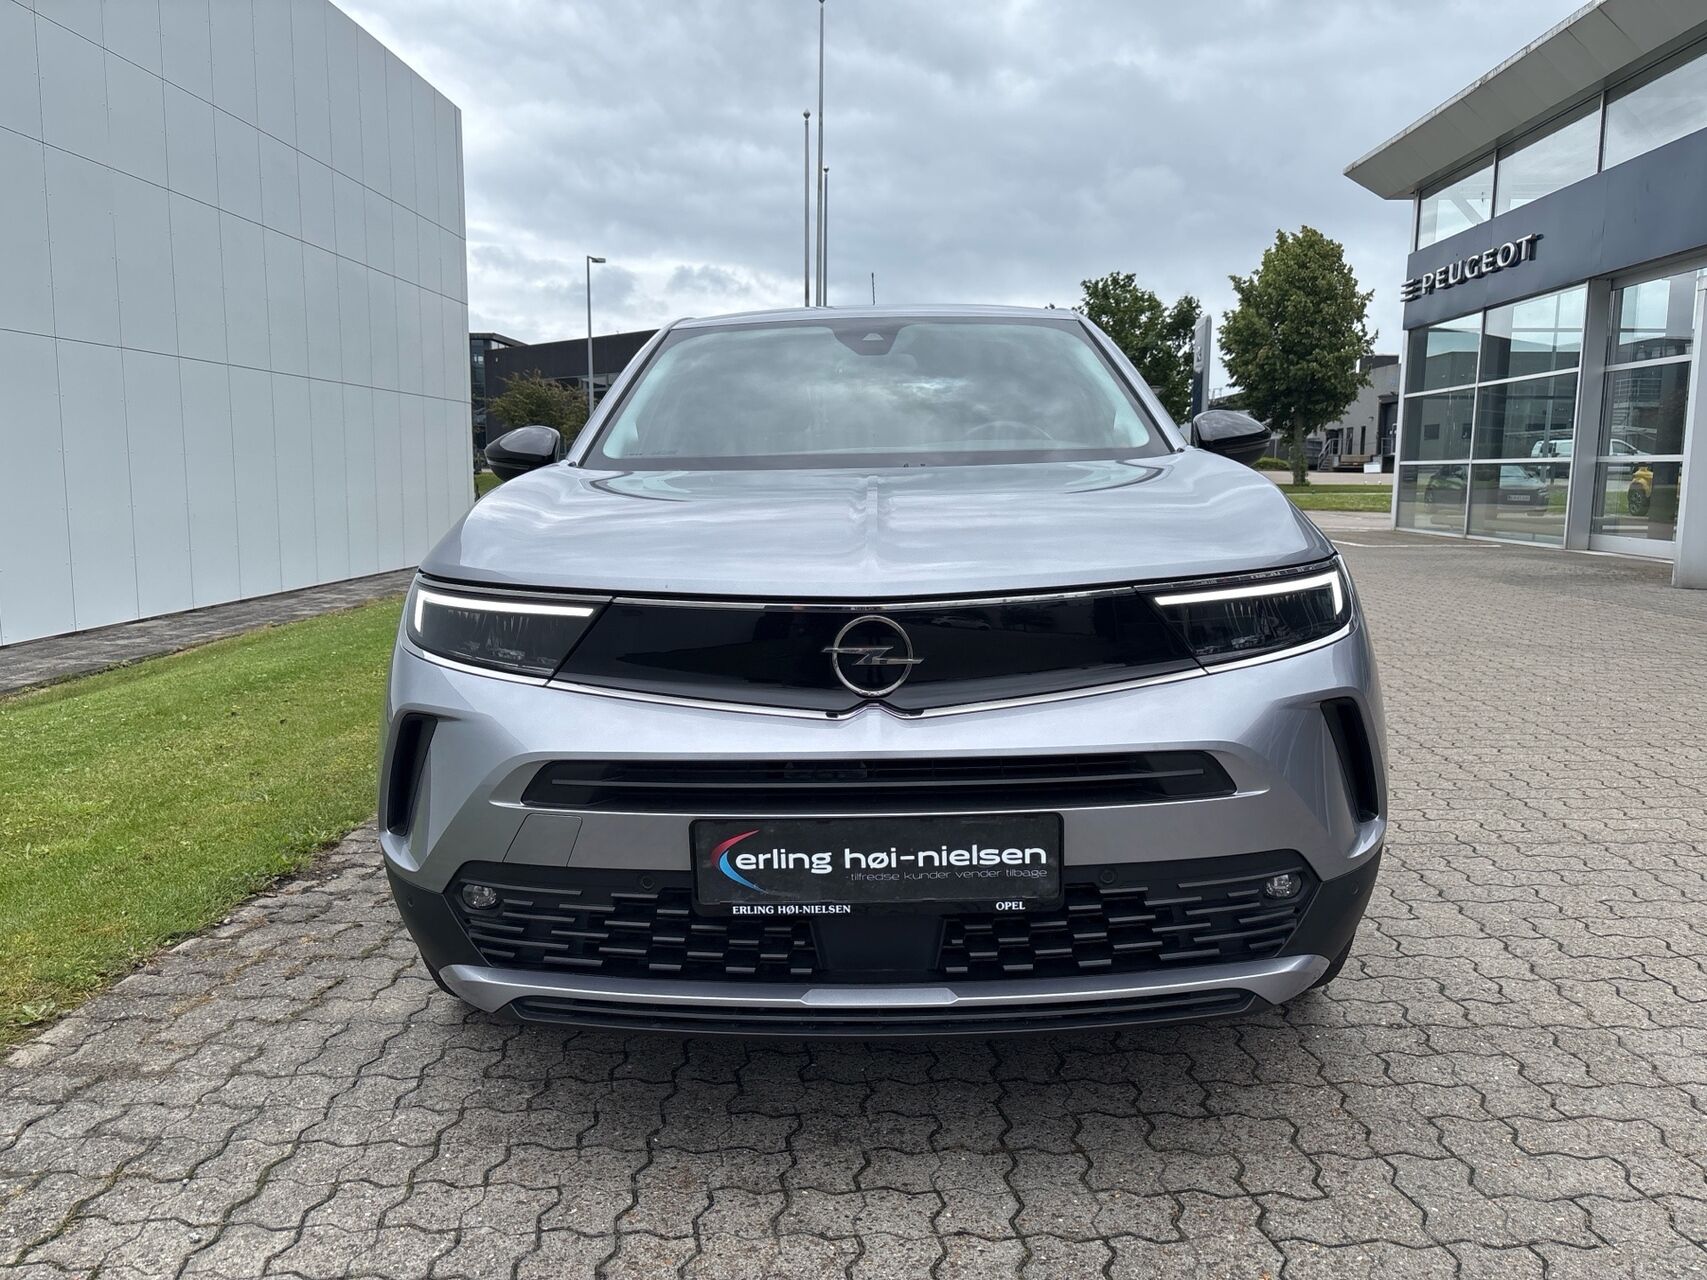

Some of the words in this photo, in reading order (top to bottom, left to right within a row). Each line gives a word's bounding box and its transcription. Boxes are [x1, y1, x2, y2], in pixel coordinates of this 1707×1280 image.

[1421, 233, 1540, 295] PEUGEOT
[735, 848, 833, 874] erling
[844, 844, 1047, 869] høi-nielsen
[851, 872, 900, 881] tilfredse
[903, 871, 951, 880] kunder
[955, 869, 1001, 878] vender
[1005, 868, 1048, 879] tilbage
[732, 905, 774, 915] ERLING
[777, 904, 851, 915] HØI-NIELSEN
[995, 901, 1026, 911] OPEL
